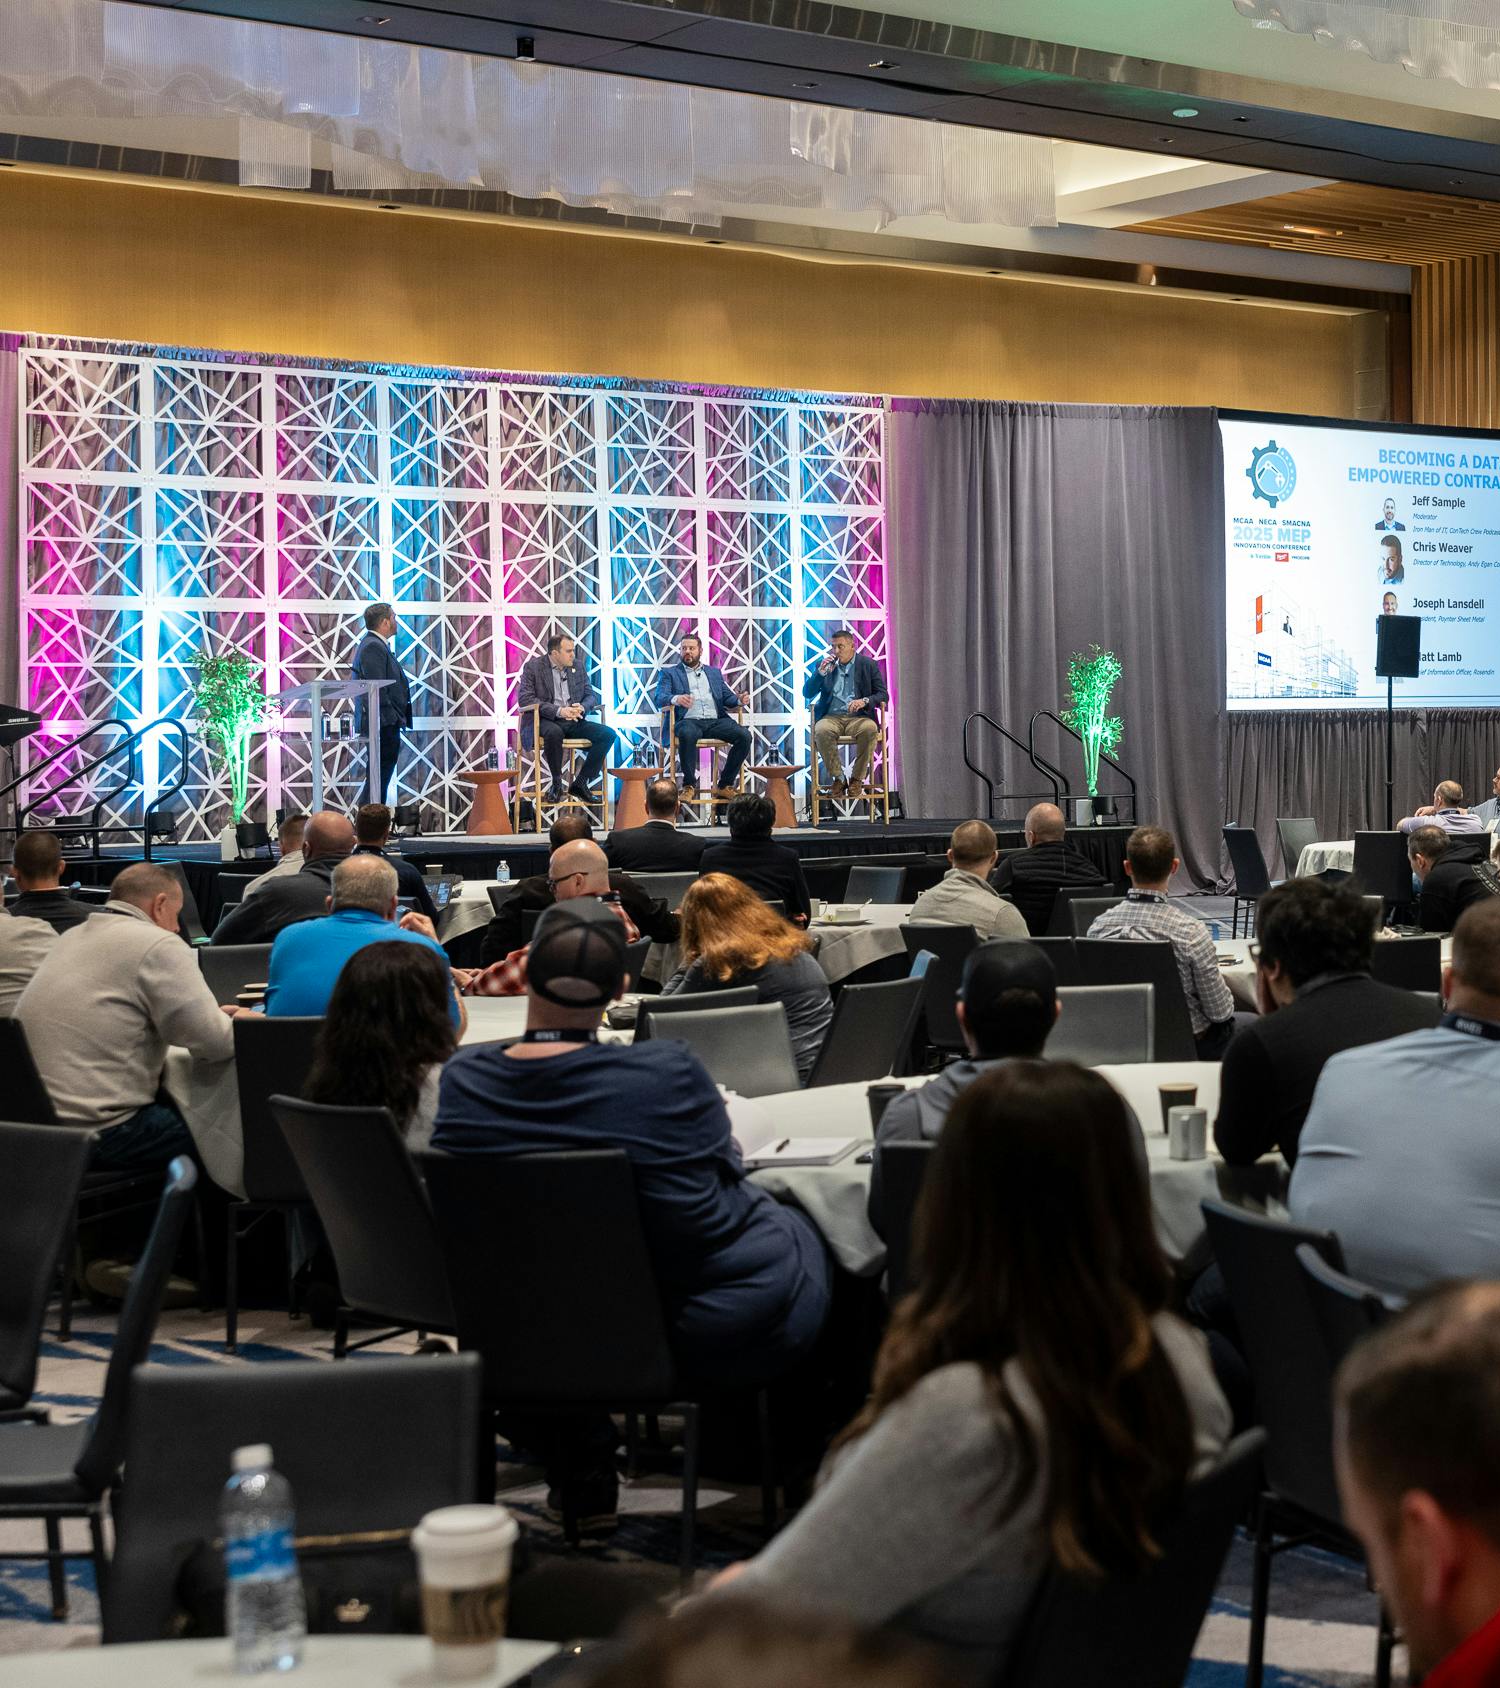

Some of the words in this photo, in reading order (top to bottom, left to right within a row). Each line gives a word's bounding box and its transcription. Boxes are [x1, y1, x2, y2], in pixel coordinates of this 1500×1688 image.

[1379, 449, 1455, 468] BECOMING
[1459, 455, 1468, 468] A
[1348, 467, 1440, 486] EMPOWERED
[1412, 496, 1430, 506] Jeff
[1432, 497, 1465, 509] Sample
[1233, 526, 1273, 541] 2025
[1277, 528, 1311, 543] MEP
[1413, 541, 1436, 552] Chris
[1439, 542, 1473, 553] Weaver
[1413, 598, 1445, 610] Joseph
[1448, 598, 1484, 609] Lansdell
[1437, 652, 1462, 661] Lamb
